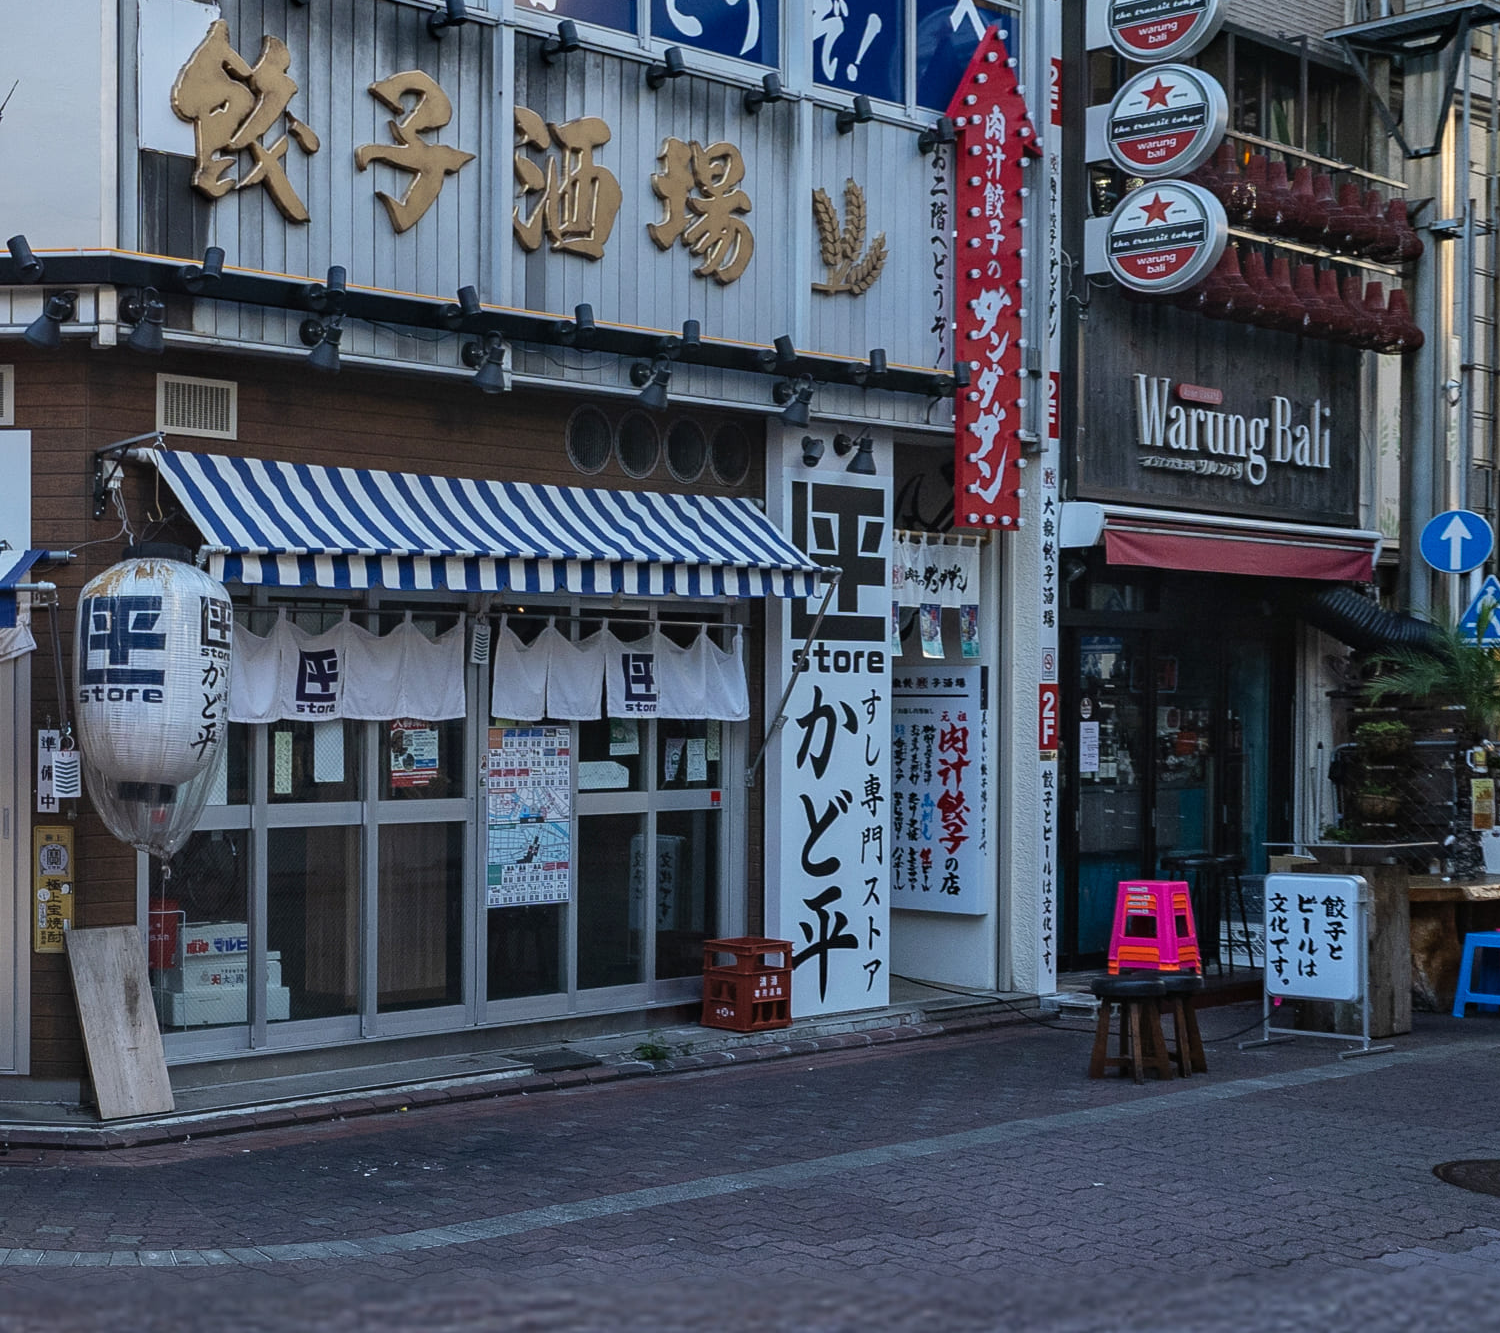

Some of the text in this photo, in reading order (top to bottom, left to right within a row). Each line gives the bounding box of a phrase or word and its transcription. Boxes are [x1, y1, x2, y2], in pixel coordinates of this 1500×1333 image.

[1138, 20, 1178, 36] warung
[1148, 31, 1168, 44] bali
[170, 17, 756, 286] 餃子酒場
[1137, 137, 1177, 152] warung
[1147, 147, 1167, 160] bali
[1137, 252, 1177, 267] warung
[1147, 262, 1167, 274] bali
[1133, 373, 1332, 486] Warung Bali
[791, 646, 885, 674] store
[79, 686, 165, 704] store
[190, 661, 226, 763] かど平
[296, 702, 336, 714] store
[1043, 691, 1055, 745] 2F
[937, 722, 971, 896] 肉汁餃子の店
[792, 685, 859, 1005] かど平
[859, 688, 885, 993] すし専門ストア
[1268, 892, 1290, 986] 文化です。
[1297, 893, 1318, 978] ビールは
[1321, 894, 1349, 961] 餃子と
